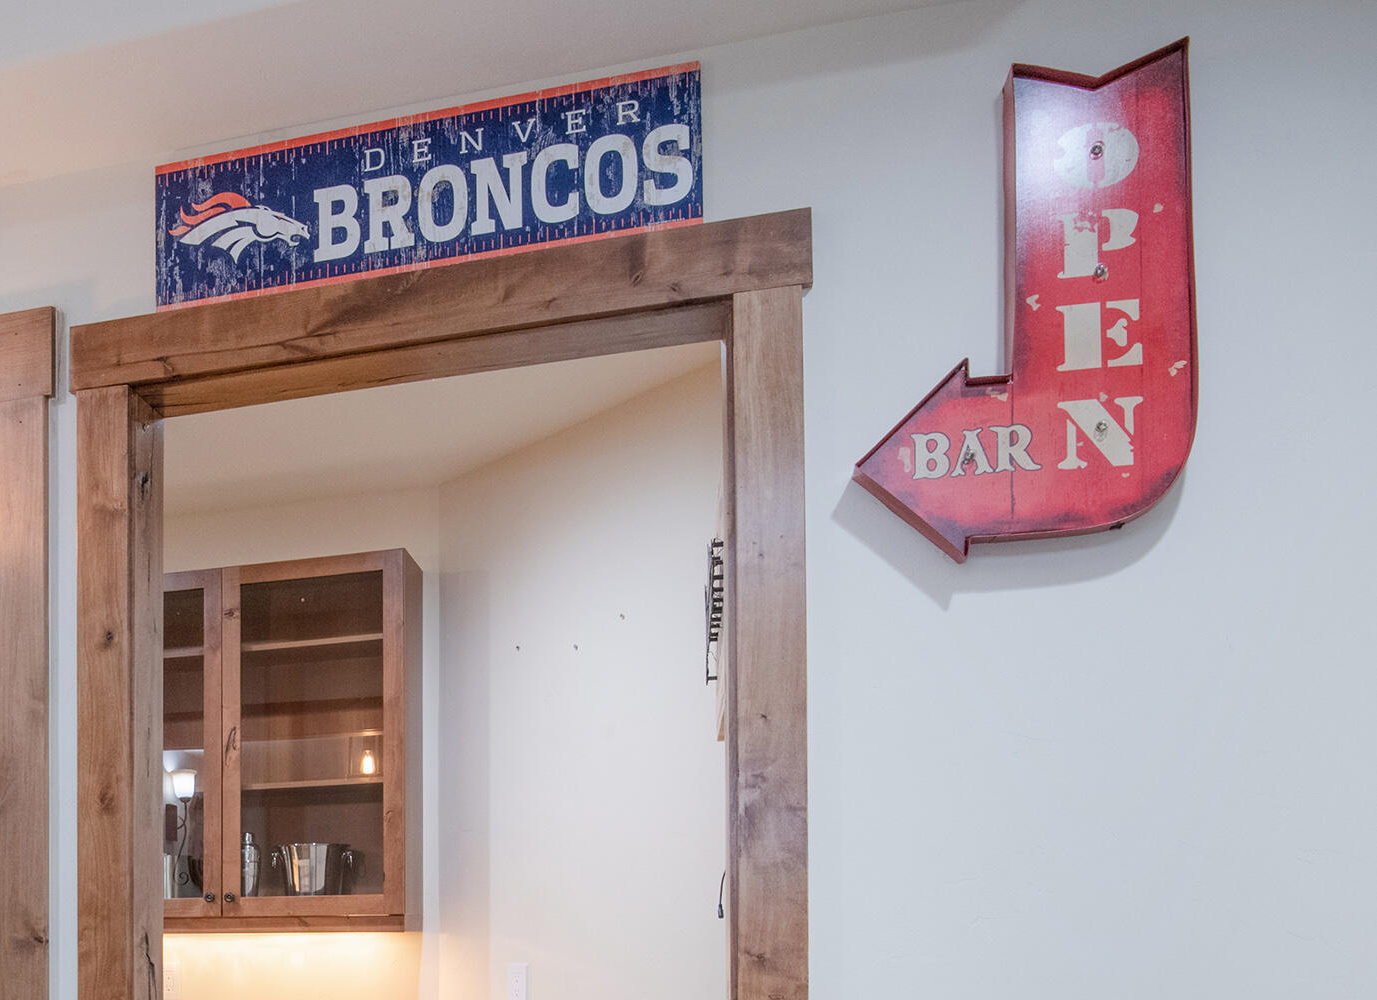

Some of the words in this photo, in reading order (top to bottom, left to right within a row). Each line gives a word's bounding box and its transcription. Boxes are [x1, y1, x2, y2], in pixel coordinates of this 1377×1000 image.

[363, 99, 641, 173] DENVER
[312, 122, 694, 264] BRONCOS
[1054, 121, 1144, 470] OPEN
[910, 423, 1043, 480] BAR
